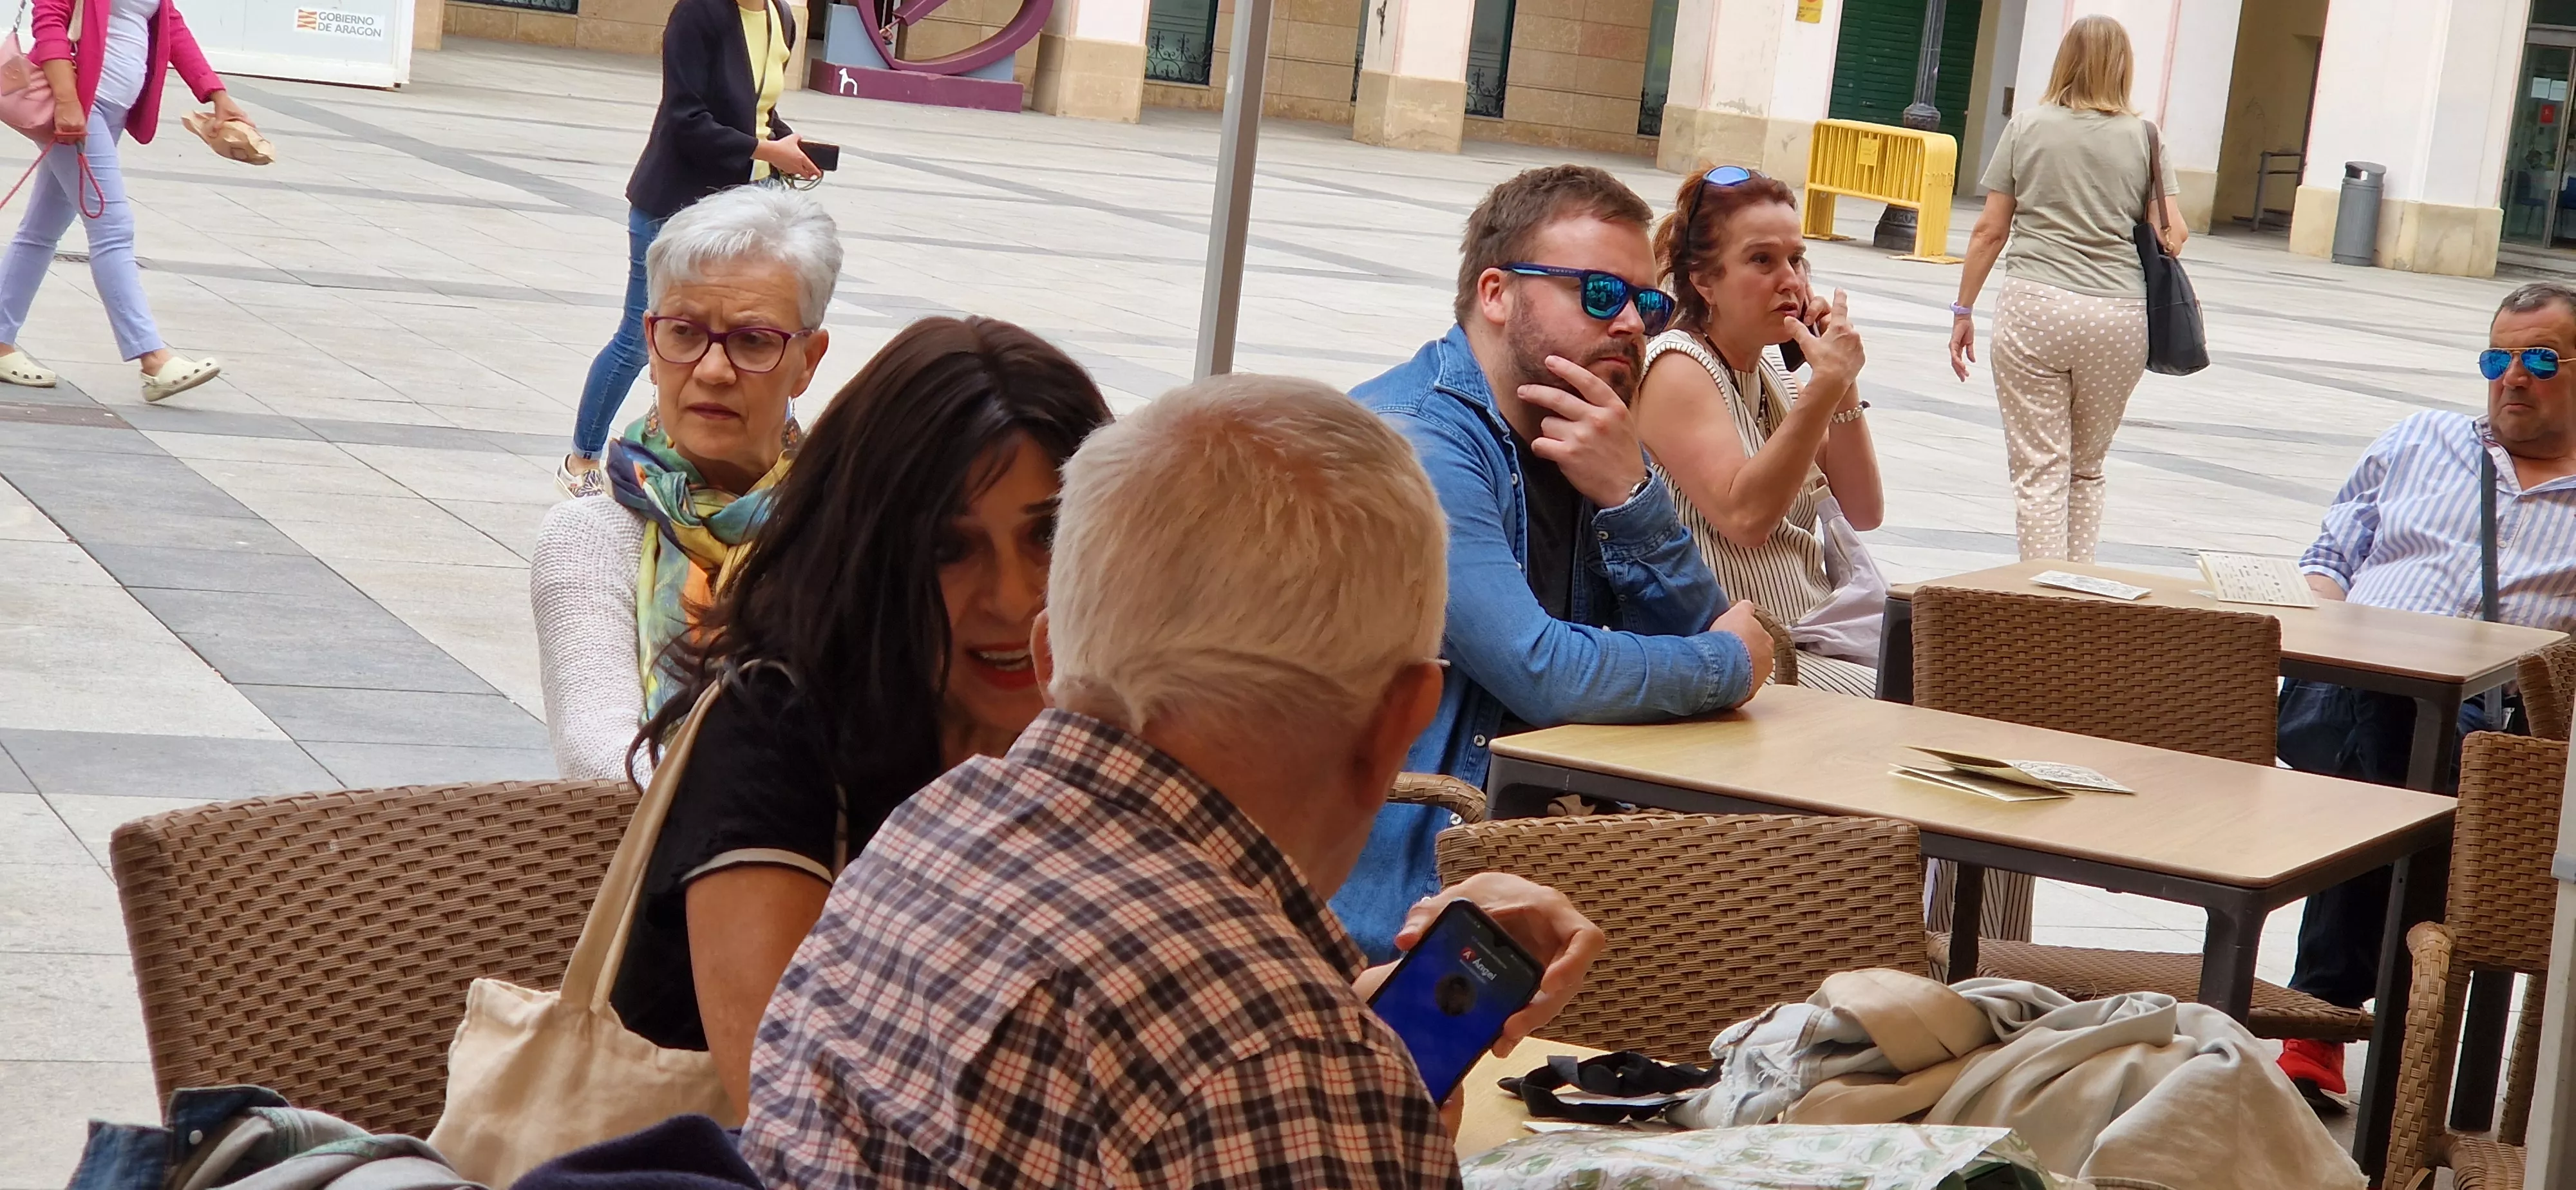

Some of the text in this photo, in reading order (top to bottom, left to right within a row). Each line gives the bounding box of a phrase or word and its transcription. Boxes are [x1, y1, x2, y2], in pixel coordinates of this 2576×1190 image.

[318, 12, 374, 26] GOBIERNO
[317, 22, 381, 37] DE ARAGON
